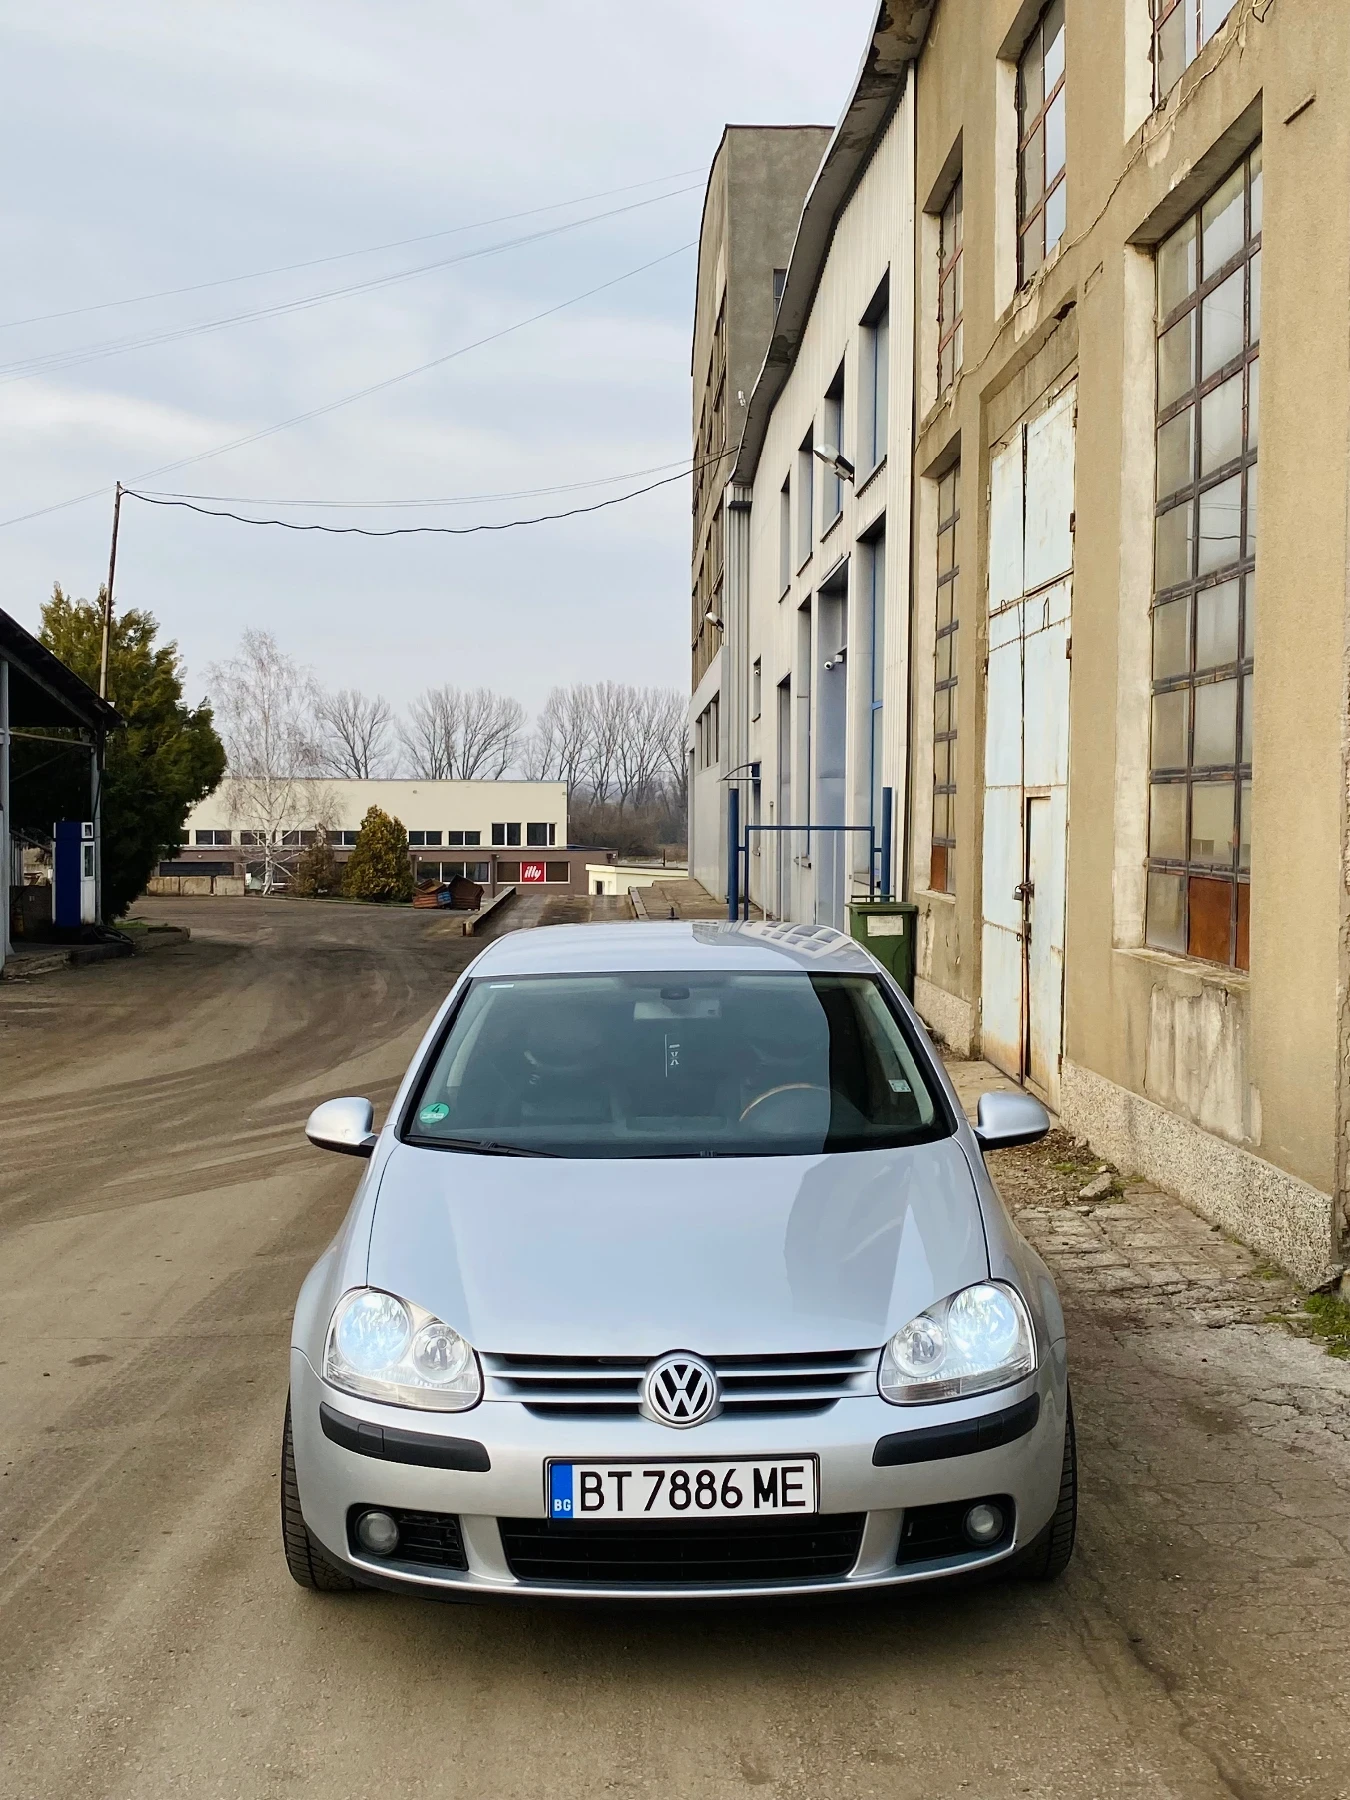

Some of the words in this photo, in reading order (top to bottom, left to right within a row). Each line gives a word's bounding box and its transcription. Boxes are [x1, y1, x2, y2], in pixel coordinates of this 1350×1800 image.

[524, 865, 542, 881] illy
[431, 1103, 441, 1113] 4
[652, 1362, 710, 1419] VW
[580, 1471, 632, 1512] BT
[643, 1469, 743, 1512] 7886
[753, 1466, 806, 1509] ME
[554, 1498, 571, 1512] BG
